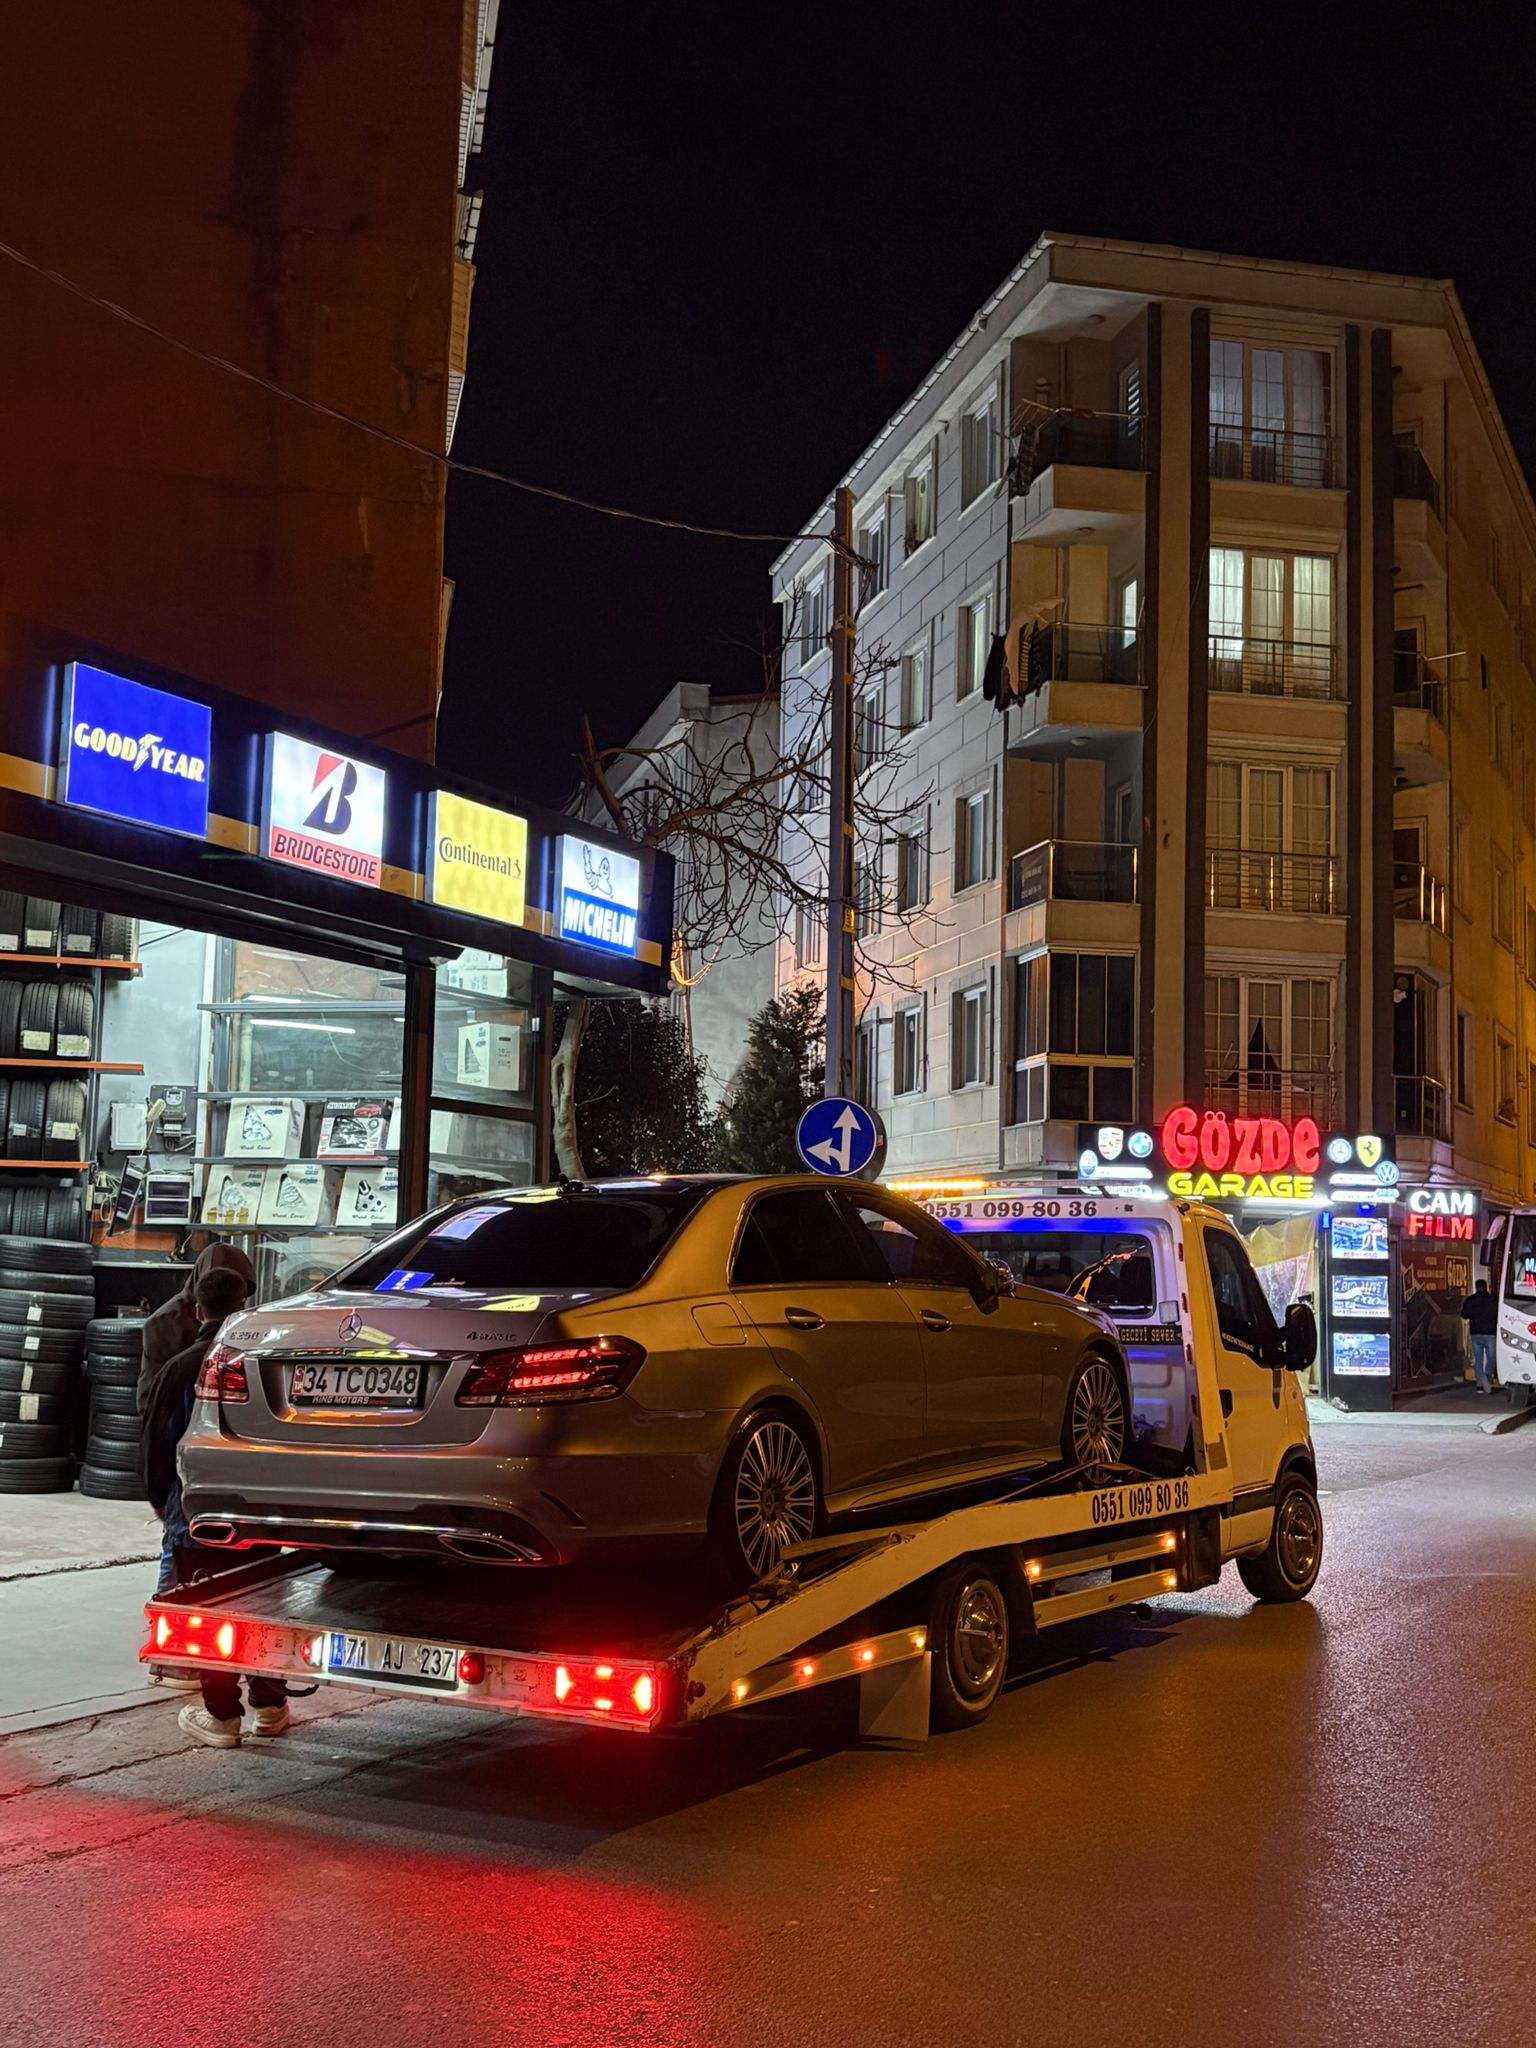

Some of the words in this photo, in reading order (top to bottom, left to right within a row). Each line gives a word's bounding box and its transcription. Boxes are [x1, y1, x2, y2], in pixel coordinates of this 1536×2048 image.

[74, 723, 205, 782] GOODYEAR
[274, 833, 377, 879] BRIDGESTONE
[439, 837, 511, 877] Continental
[564, 896, 637, 948] MICHELIN
[1168, 1172, 1315, 1198] GARAGE
[1410, 1190, 1474, 1215] CAM
[923, 1202, 974, 1218] 0551
[983, 1202, 1024, 1217] 099
[1032, 1202, 1061, 1217] 80
[1068, 1201, 1097, 1217] 36
[303, 1367, 328, 1393] 34
[312, 1395, 333, 1404] KING
[335, 1396, 370, 1405] MOTORS
[1092, 1491, 1124, 1524] 0551
[1129, 1486, 1152, 1517] 099
[1156, 1483, 1171, 1512] 80
[1174, 1480, 1189, 1508] 36
[345, 1638, 367, 1666] 71
[383, 1643, 405, 1670] AJ
[420, 1648, 454, 1677] 237
